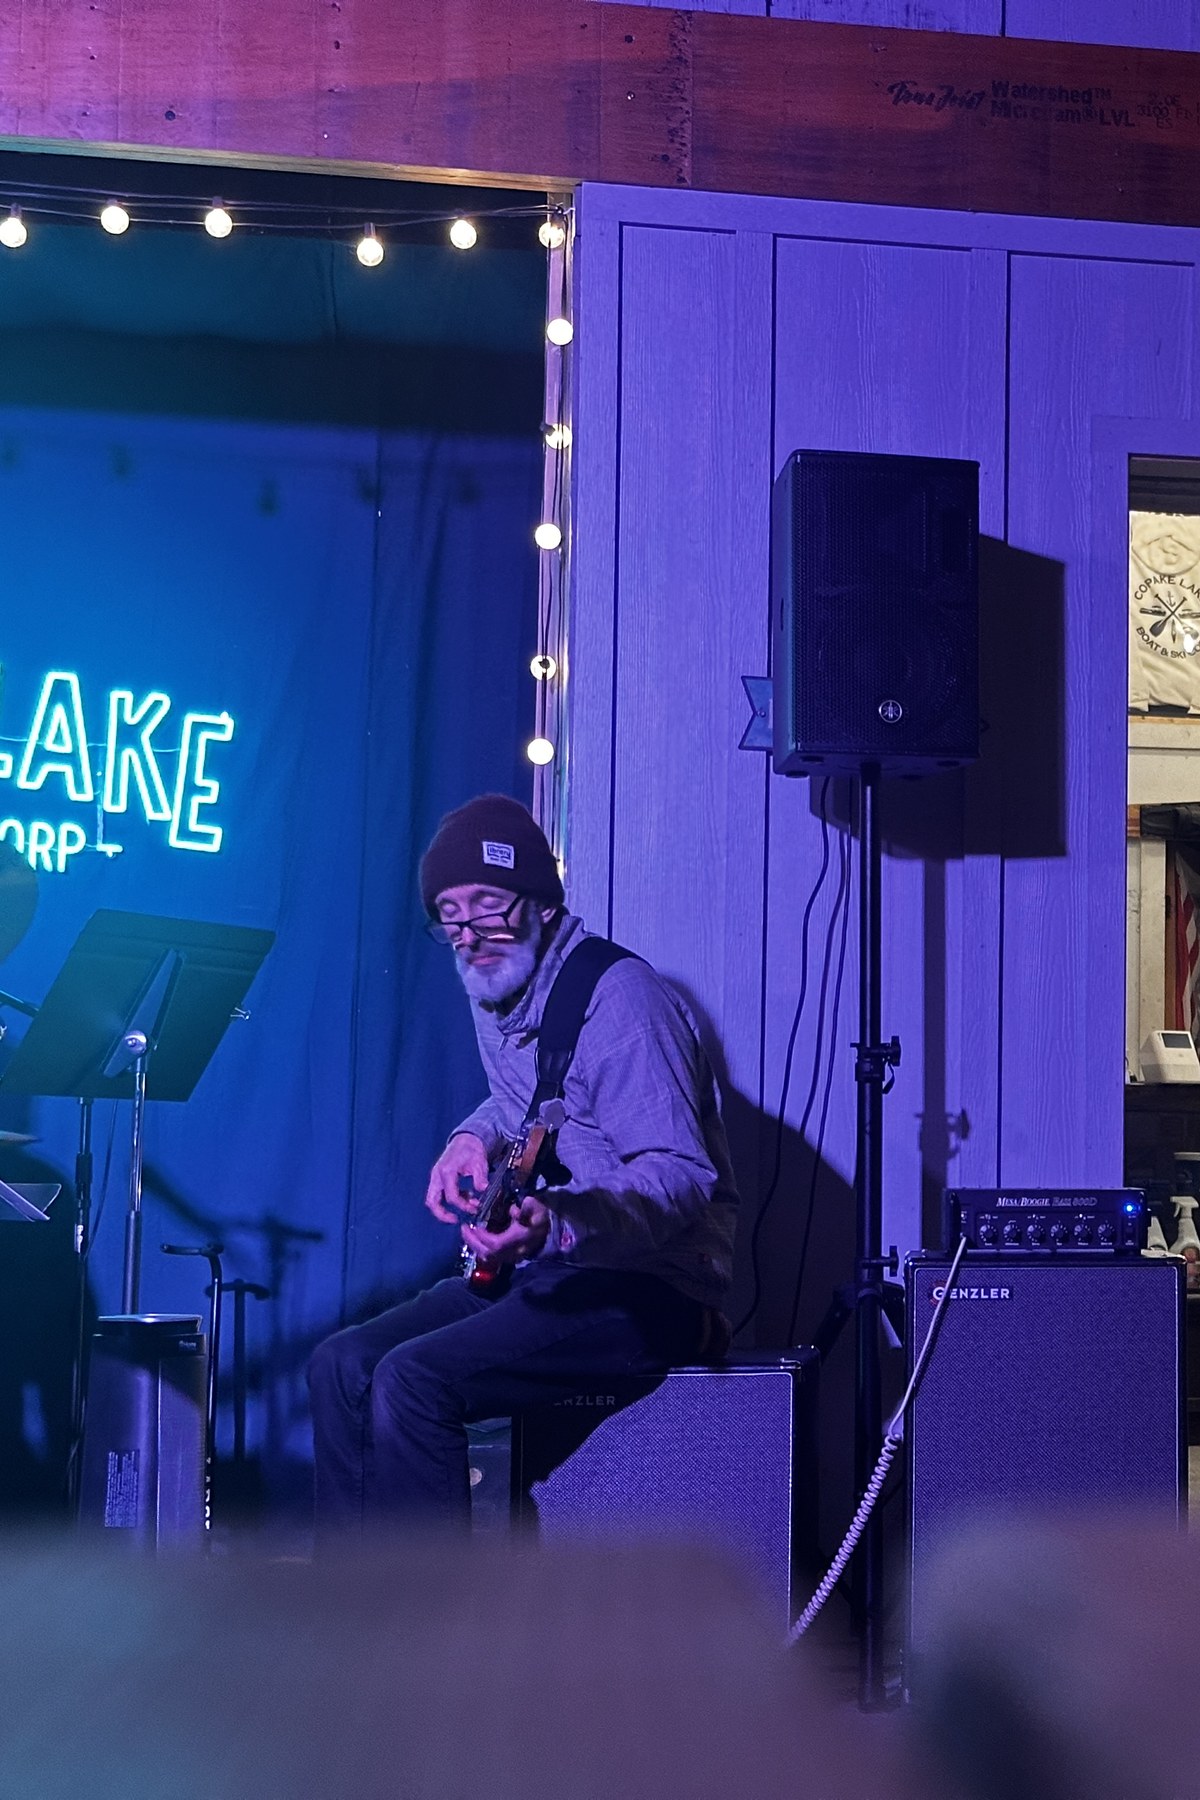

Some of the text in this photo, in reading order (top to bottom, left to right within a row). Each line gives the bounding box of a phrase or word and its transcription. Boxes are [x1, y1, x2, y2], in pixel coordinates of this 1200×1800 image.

[1099, 107, 1136, 127] LVL
[1134, 575, 1176, 600] COPAKE
[1136, 626, 1161, 651] BOAT
[1160, 647, 1169, 657] &
[1170, 650, 1187, 659] SKI
[0, 671, 235, 853] AKE
[932, 1287, 1010, 1301] GENZLER
